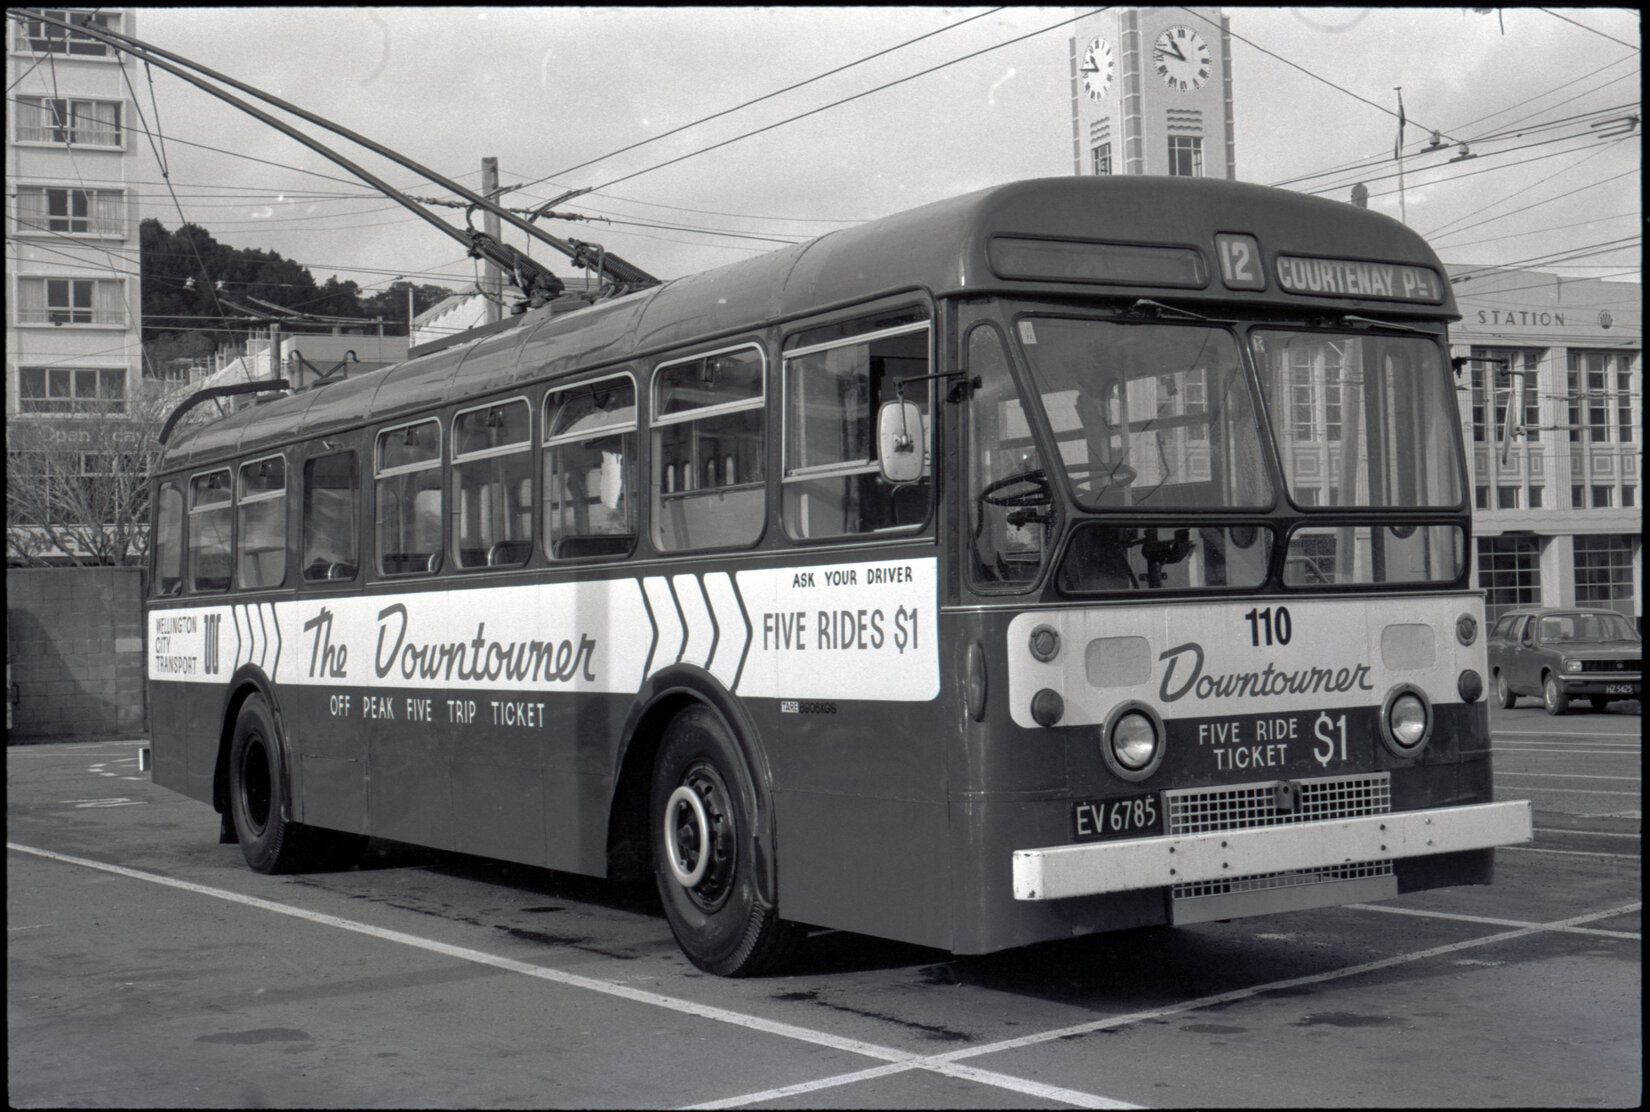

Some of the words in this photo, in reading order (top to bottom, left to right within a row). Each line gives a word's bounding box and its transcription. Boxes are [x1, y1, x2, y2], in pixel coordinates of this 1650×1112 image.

[1219, 240, 1254, 281] 12
[1277, 257, 1394, 297] COURTENAY
[1478, 310, 1565, 327] STATION
[792, 572, 816, 588] ASK
[825, 570, 857, 586] YOUR
[867, 566, 913, 585] DRIVER
[156, 616, 197, 635] WELLINGTON
[303, 606, 347, 678] The
[374, 602, 596, 682] Downtowner
[763, 611, 806, 650] FIVE
[817, 609, 885, 650] RIDES
[894, 604, 918, 654] $1
[1245, 606, 1292, 647] 110
[155, 636, 171, 654] CITY
[155, 655, 197, 675] TRANSPORT
[1158, 642, 1374, 703] Downtowner
[330, 694, 350, 717] OFF
[363, 696, 395, 720] PEAK
[406, 698, 432, 722] FIVE
[447, 700, 476, 724] TRIP
[491, 701, 545, 728] TICKET
[1199, 722, 1240, 745] FIVE
[1256, 718, 1298, 741] RIDE
[1313, 711, 1347, 767] $1
[1213, 743, 1288, 770] TICKET
[1076, 803, 1105, 835] EV
[1110, 798, 1156, 831] 6785
